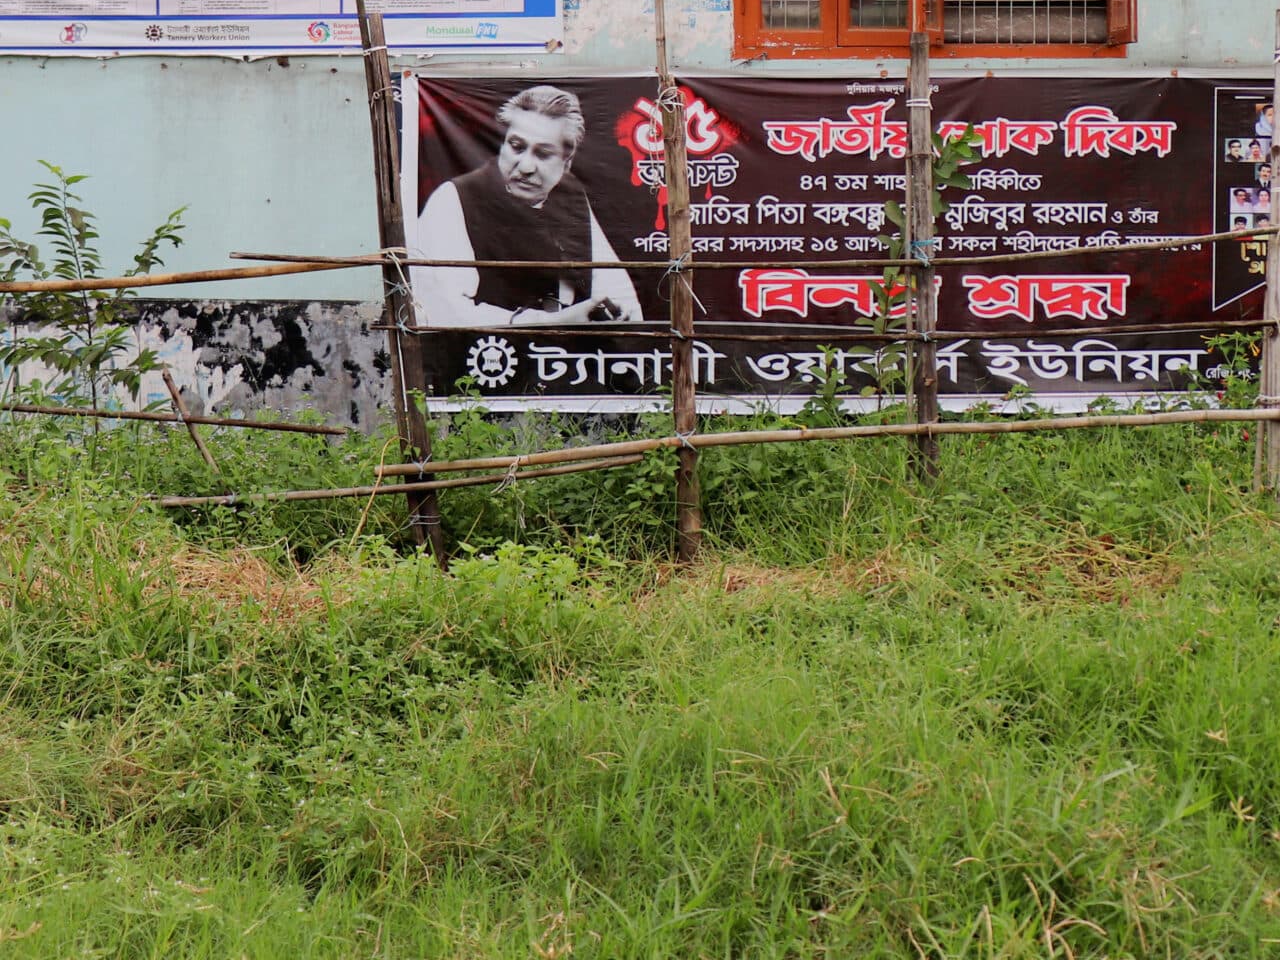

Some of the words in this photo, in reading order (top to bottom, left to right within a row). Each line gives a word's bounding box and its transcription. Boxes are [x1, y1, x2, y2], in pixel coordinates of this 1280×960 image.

[762, 98, 908, 163] জাতীয়
[1061, 105, 1177, 158] দিবস
[800, 175, 828, 191] ৪৭
[834, 174, 867, 191] তম
[756, 195, 807, 224] পিতা
[812, 202, 887, 231] বঙ্গবন্ধু
[945, 194, 1027, 232] মুজিবুর
[1032, 202, 1108, 225] রহমান
[1111, 211, 1124, 224] ও
[1129, 207, 1160, 225] তাঁর
[730, 235, 805, 254] সদস্যসহ
[811, 238, 838, 253] ১৫
[949, 235, 997, 252] সকল
[962, 274, 1131, 323] শ্রদ্ধা
[979, 339, 1210, 387] ইউনিয়ন
